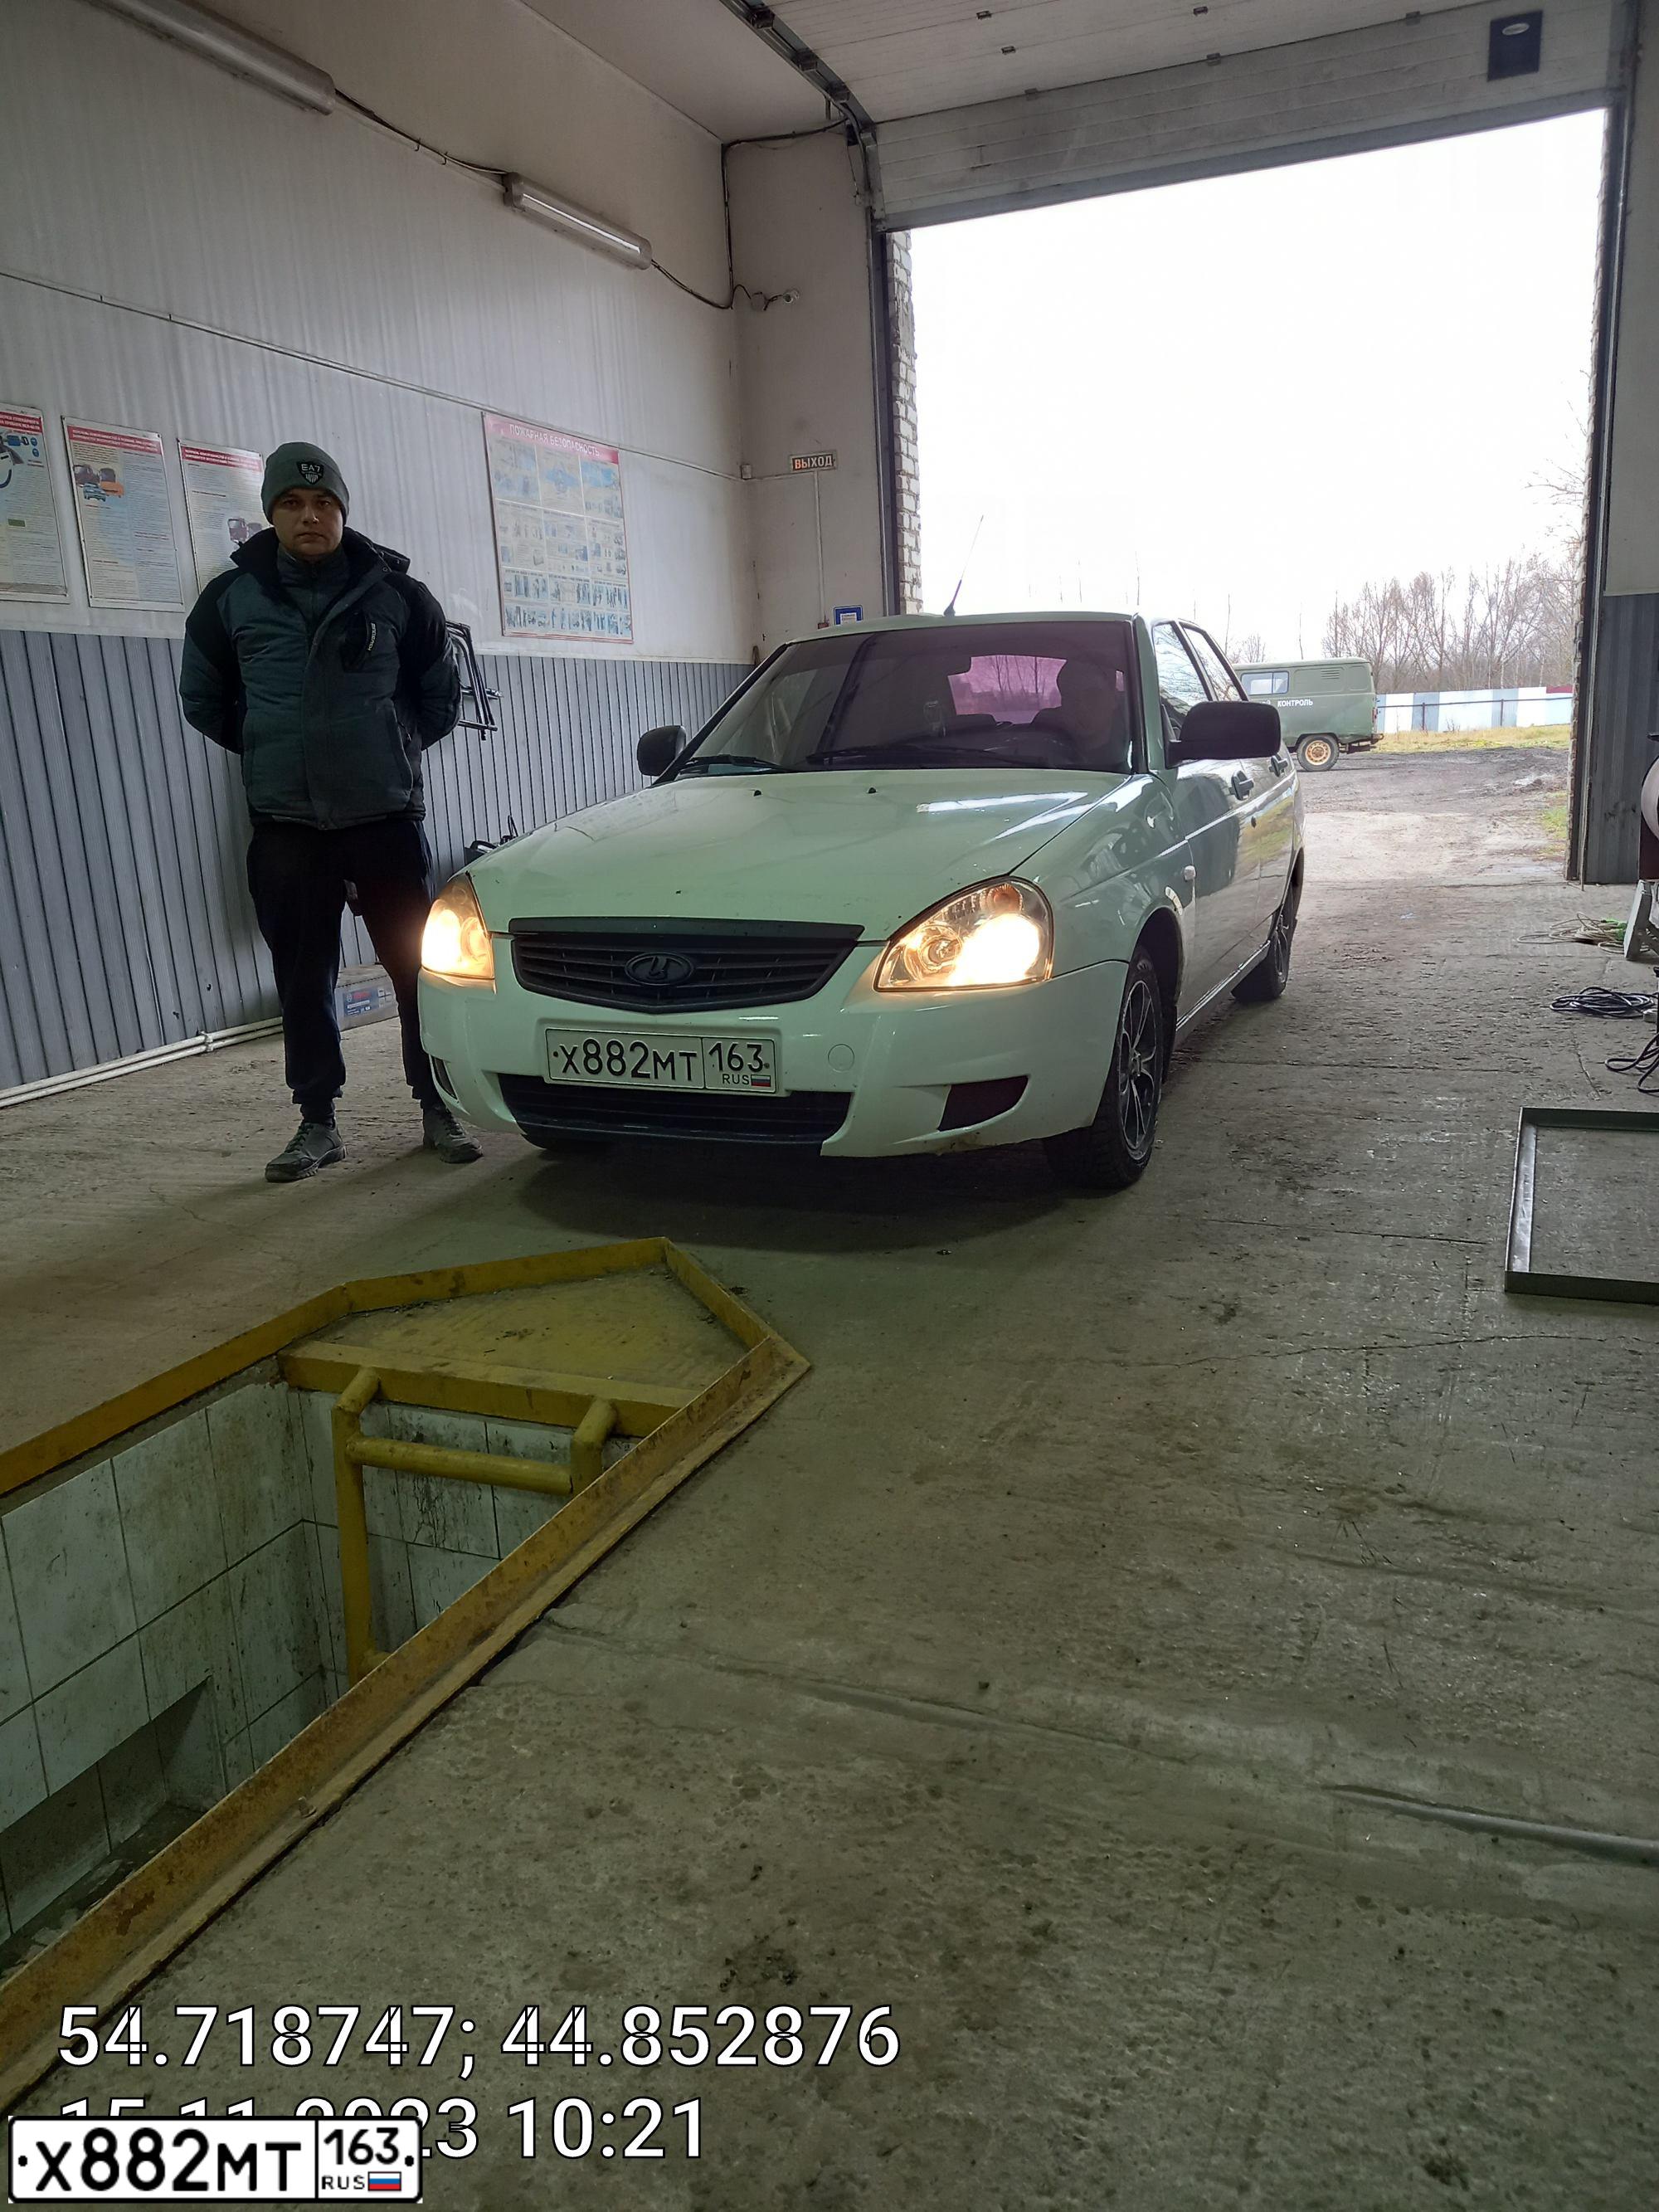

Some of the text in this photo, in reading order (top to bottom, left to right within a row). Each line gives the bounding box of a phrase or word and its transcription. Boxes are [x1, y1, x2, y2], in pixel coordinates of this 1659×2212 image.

[509, 424, 600, 456] ПОЖАРНАЯ БЕЗОПАСНОСТЬ
[795, 456, 832, 470] ВЫХОД
[558, 1038, 764, 1081] Х882МТ 163
[721, 1073, 751, 1085] RUS
